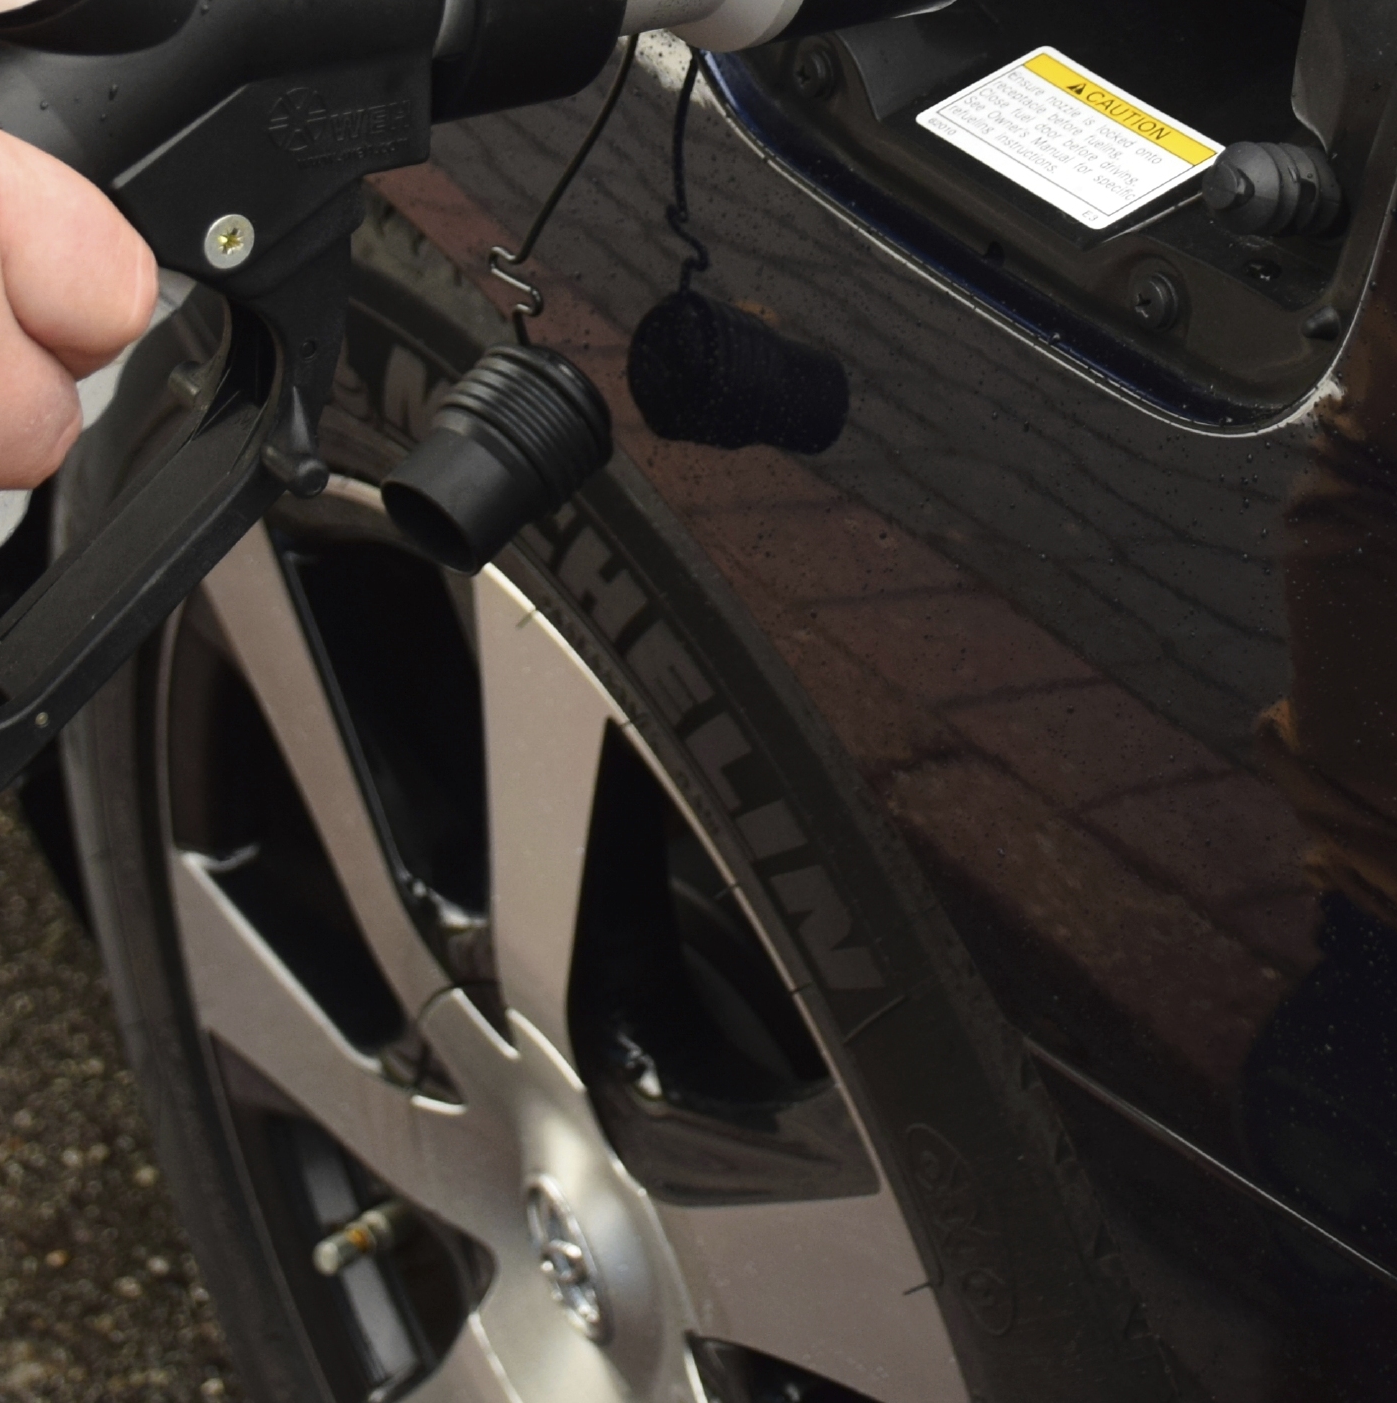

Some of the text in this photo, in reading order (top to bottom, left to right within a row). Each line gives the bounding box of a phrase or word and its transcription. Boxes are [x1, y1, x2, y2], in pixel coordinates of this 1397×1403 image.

[948, 105, 1058, 174] refueling instructions.
[963, 95, 1137, 201] See Owner's Manual for specific
[979, 87, 1139, 187] Close fuel door before driving.
[991, 80, 1123, 161] receptacle before fueling.
[1007, 71, 1163, 165] Ensure nozzle is locked onto
[1086, 91, 1171, 141] CAUTION
